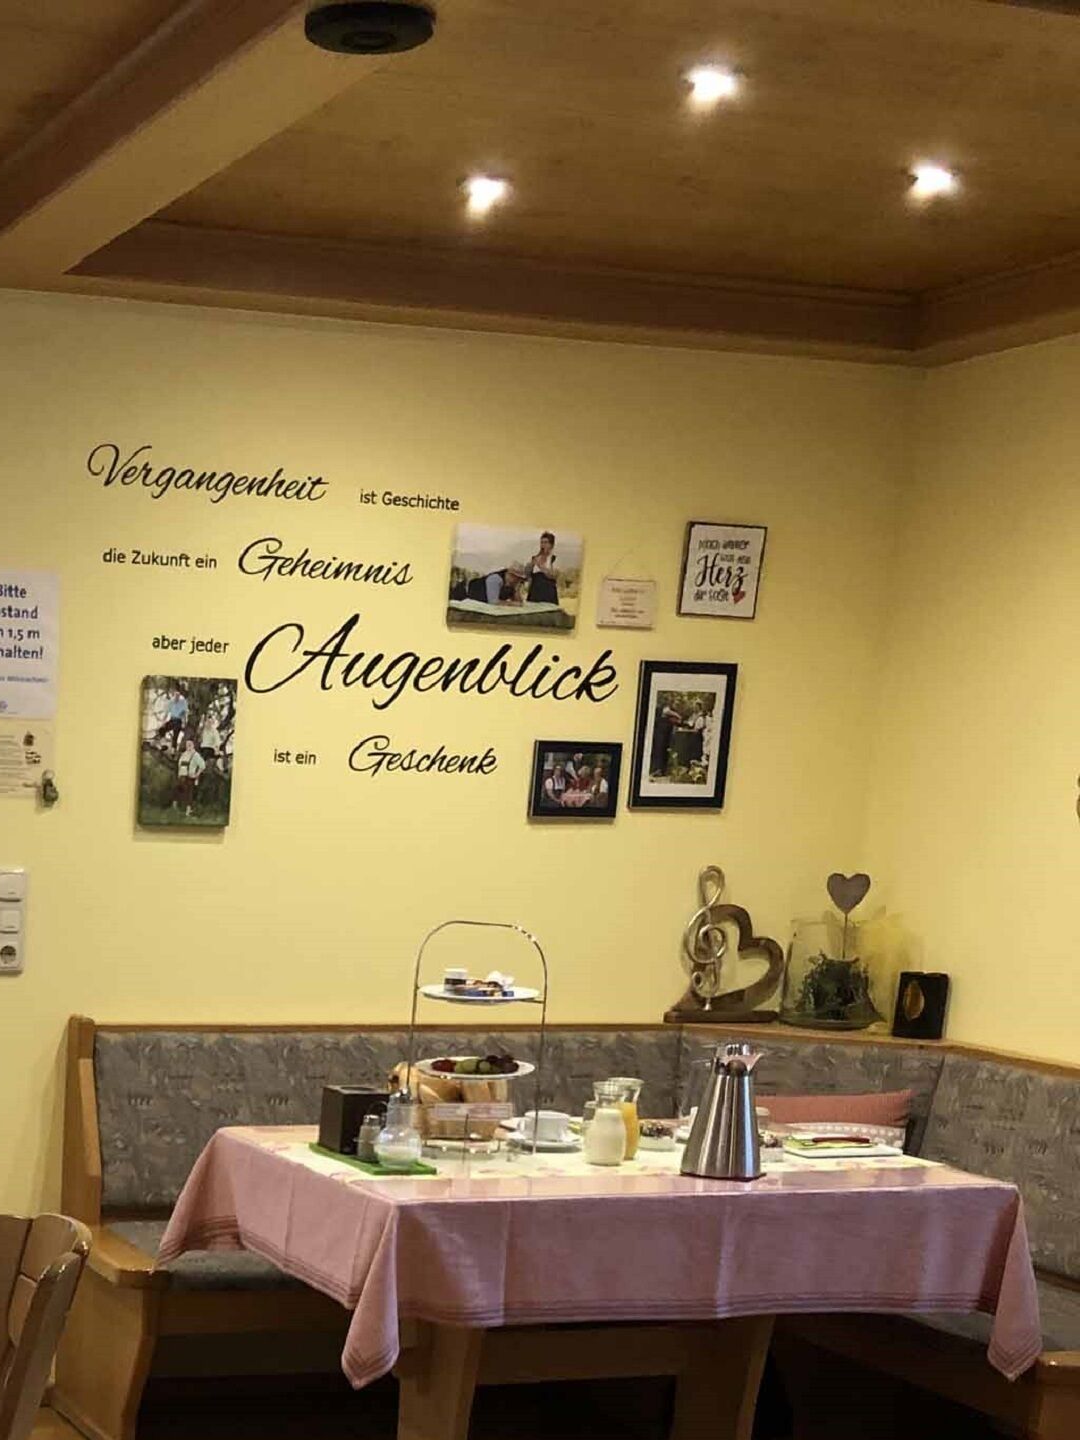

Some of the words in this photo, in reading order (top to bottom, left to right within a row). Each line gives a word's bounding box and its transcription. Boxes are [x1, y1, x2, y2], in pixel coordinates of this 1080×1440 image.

[87, 443, 329, 503] Vergangenheit
[359, 488, 377, 504] ist
[381, 491, 460, 511] Geschichte
[102, 548, 126, 564] die
[131, 550, 190, 568] Zukunft
[194, 554, 218, 569] ein
[238, 537, 414, 586] Geheimnis
[694, 553, 749, 597] Herz
[7, 627, 24, 642] 1,5
[27, 630, 41, 640] m
[152, 635, 185, 651] aber
[188, 636, 230, 655] jeder
[244, 612, 619, 711] Augenblick
[273, 748, 291, 765] ist
[294, 751, 318, 766] ein
[348, 735, 498, 777] Geschenk
